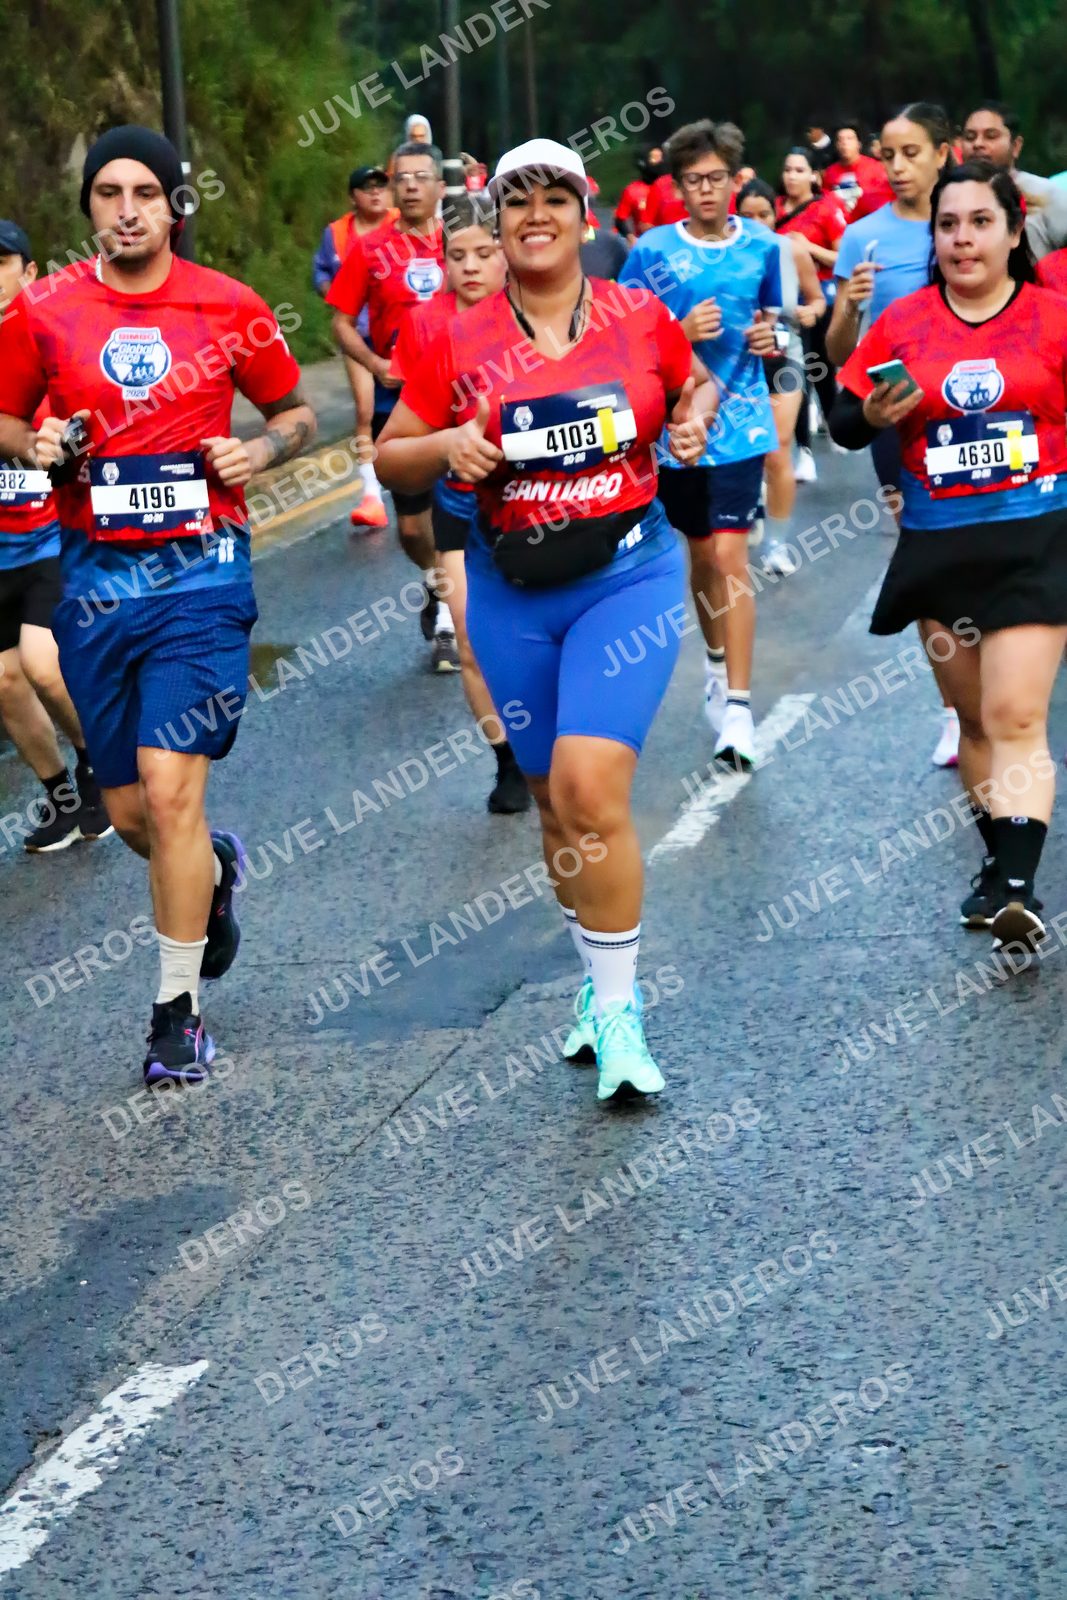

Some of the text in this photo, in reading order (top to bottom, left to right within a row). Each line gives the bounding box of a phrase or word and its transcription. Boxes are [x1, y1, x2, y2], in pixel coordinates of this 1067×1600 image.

[111, 353, 140, 363] Race
[118, 343, 154, 355] Global
[546, 421, 597, 453] 4103
[958, 442, 1005, 467] 4630
[129, 485, 176, 510] 4196
[502, 472, 623, 501] SANTIAGO
